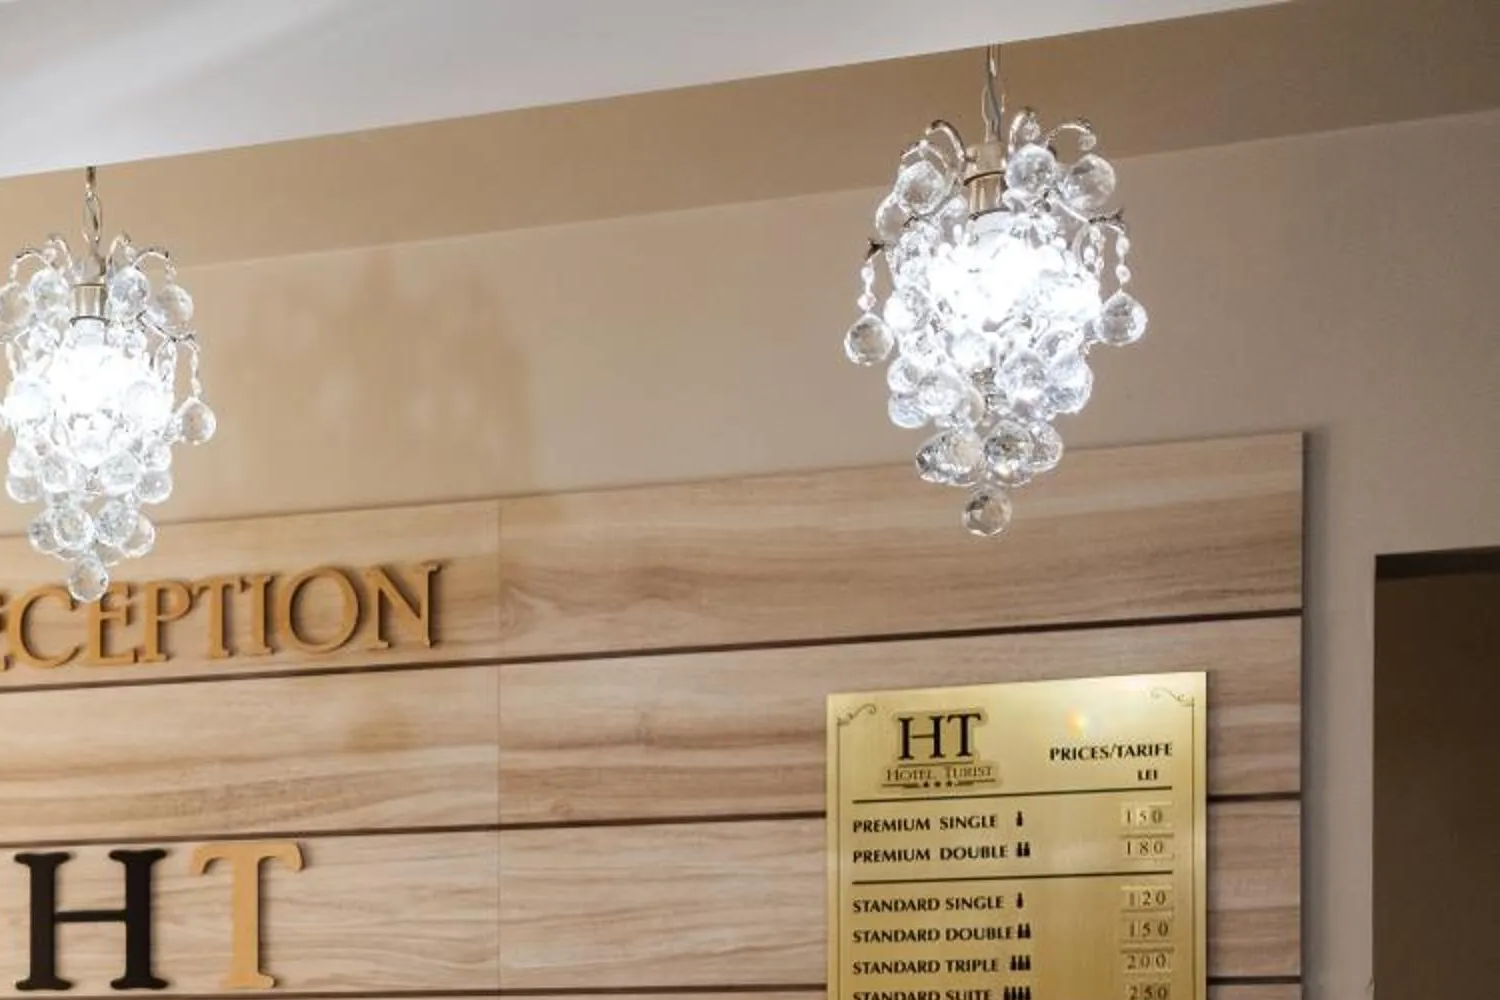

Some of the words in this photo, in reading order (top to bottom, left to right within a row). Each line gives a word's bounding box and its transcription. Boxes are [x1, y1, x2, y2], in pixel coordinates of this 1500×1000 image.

[898, 713, 982, 761] HT
[1050, 742, 1173, 762] PRICES/TARIFE
[1137, 768, 1159, 781] LEI
[852, 818, 931, 833] PREMIUM
[939, 814, 998, 831] SINGLE
[852, 848, 931, 864] PREMIUM
[939, 844, 1009, 861] DOUBLE
[852, 897, 940, 914] STANDARD
[944, 894, 1005, 910] SINGLE
[13, 841, 306, 992] HT
[852, 927, 941, 944] STANDARD
[944, 924, 1013, 941] DOUBLE
[852, 959, 941, 975] STANDARD
[945, 957, 1000, 973] TRIPLE
